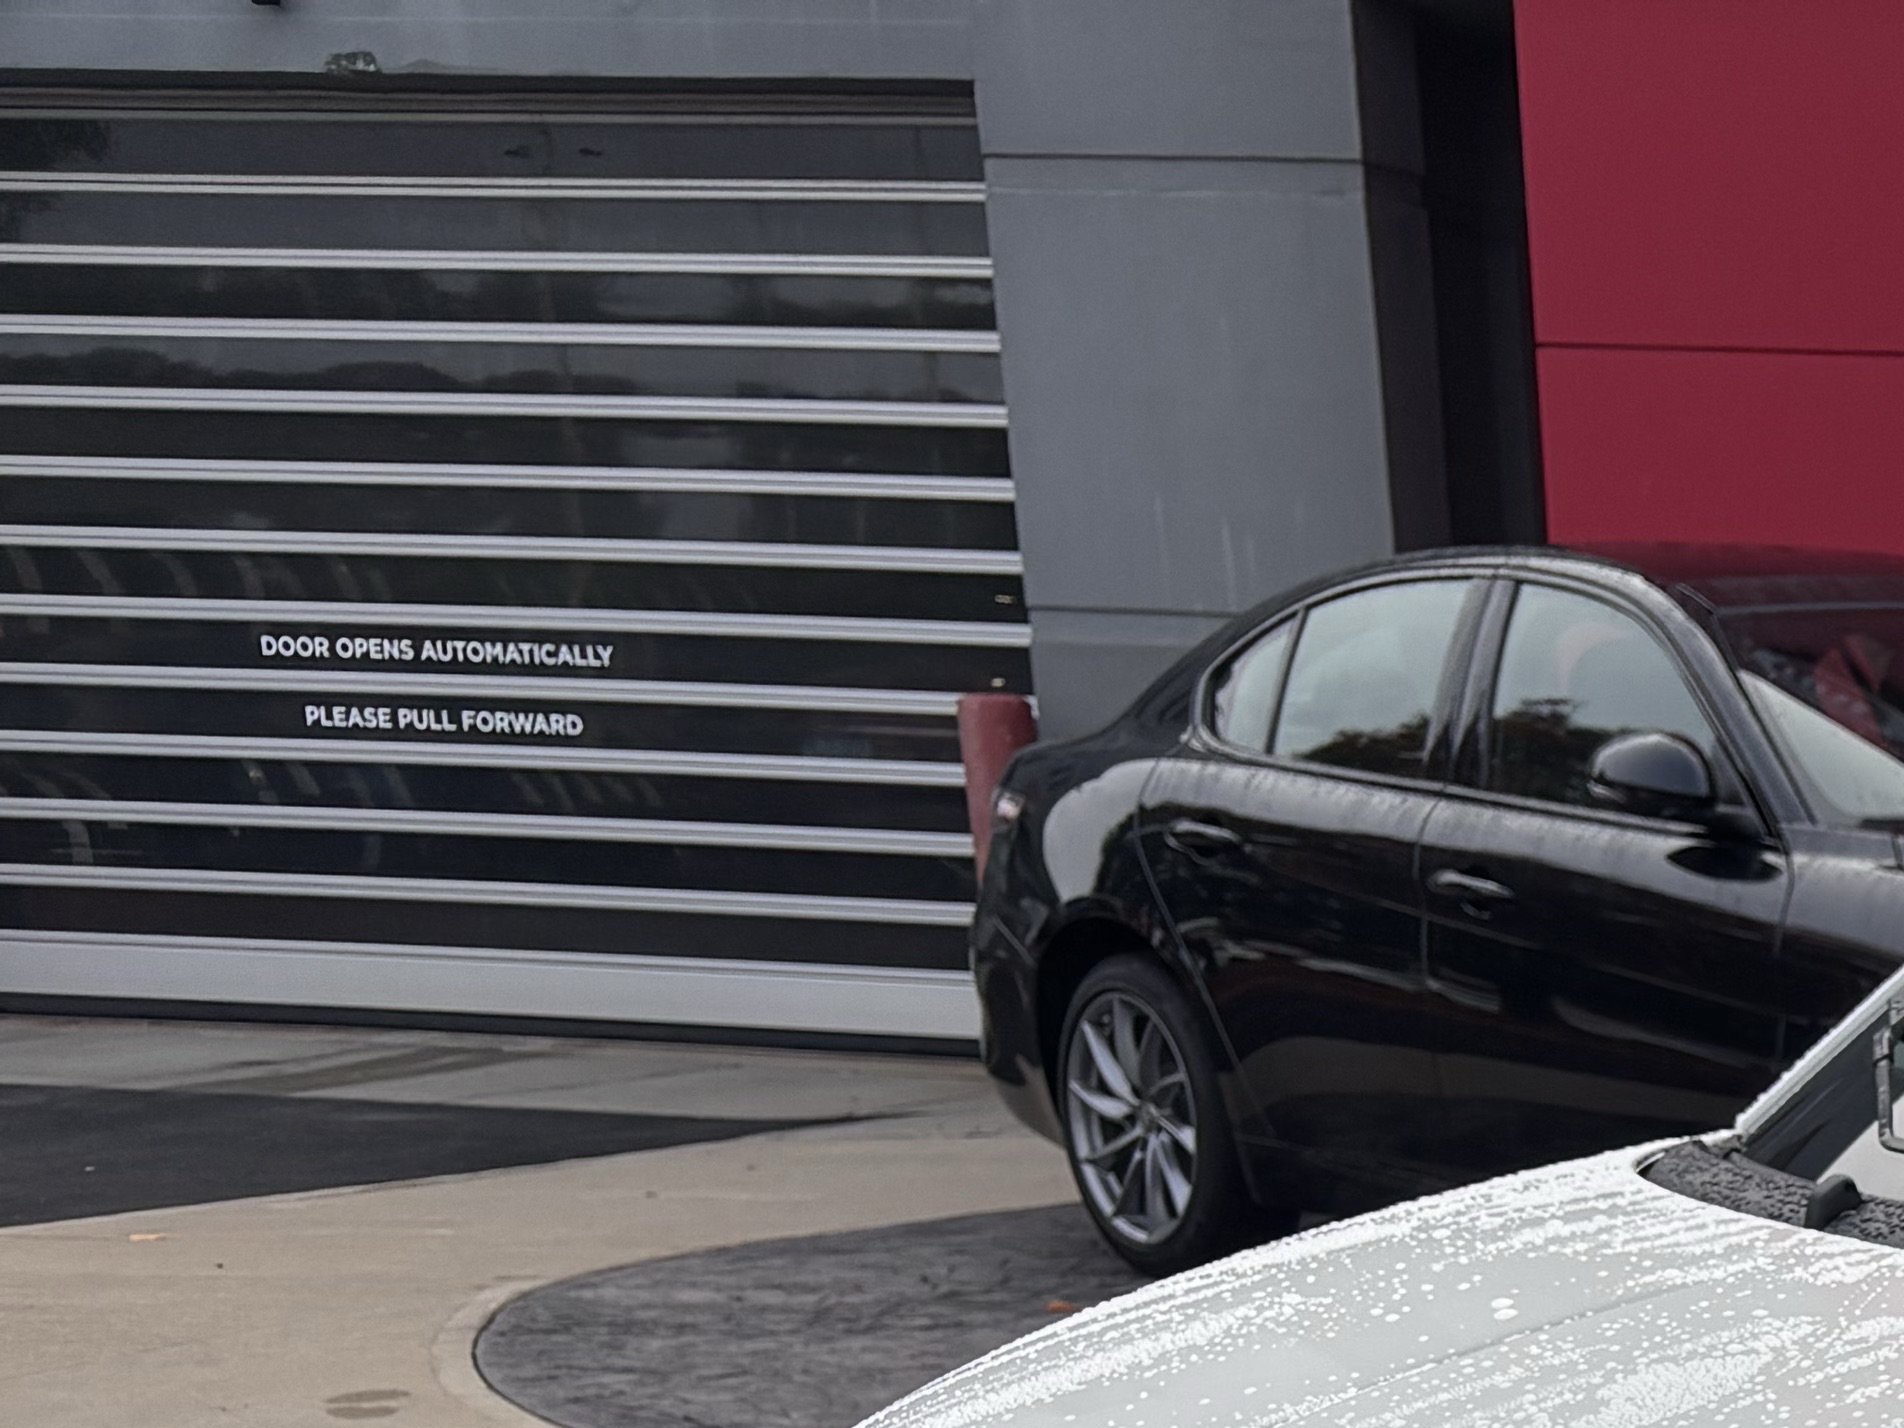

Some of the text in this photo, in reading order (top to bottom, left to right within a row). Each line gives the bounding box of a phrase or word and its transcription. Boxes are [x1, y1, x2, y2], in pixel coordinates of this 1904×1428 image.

[260, 634, 614, 668] DOOR OPENS AUTOMATICALLY
[305, 705, 584, 737] PLEASE PULL FORWARD
